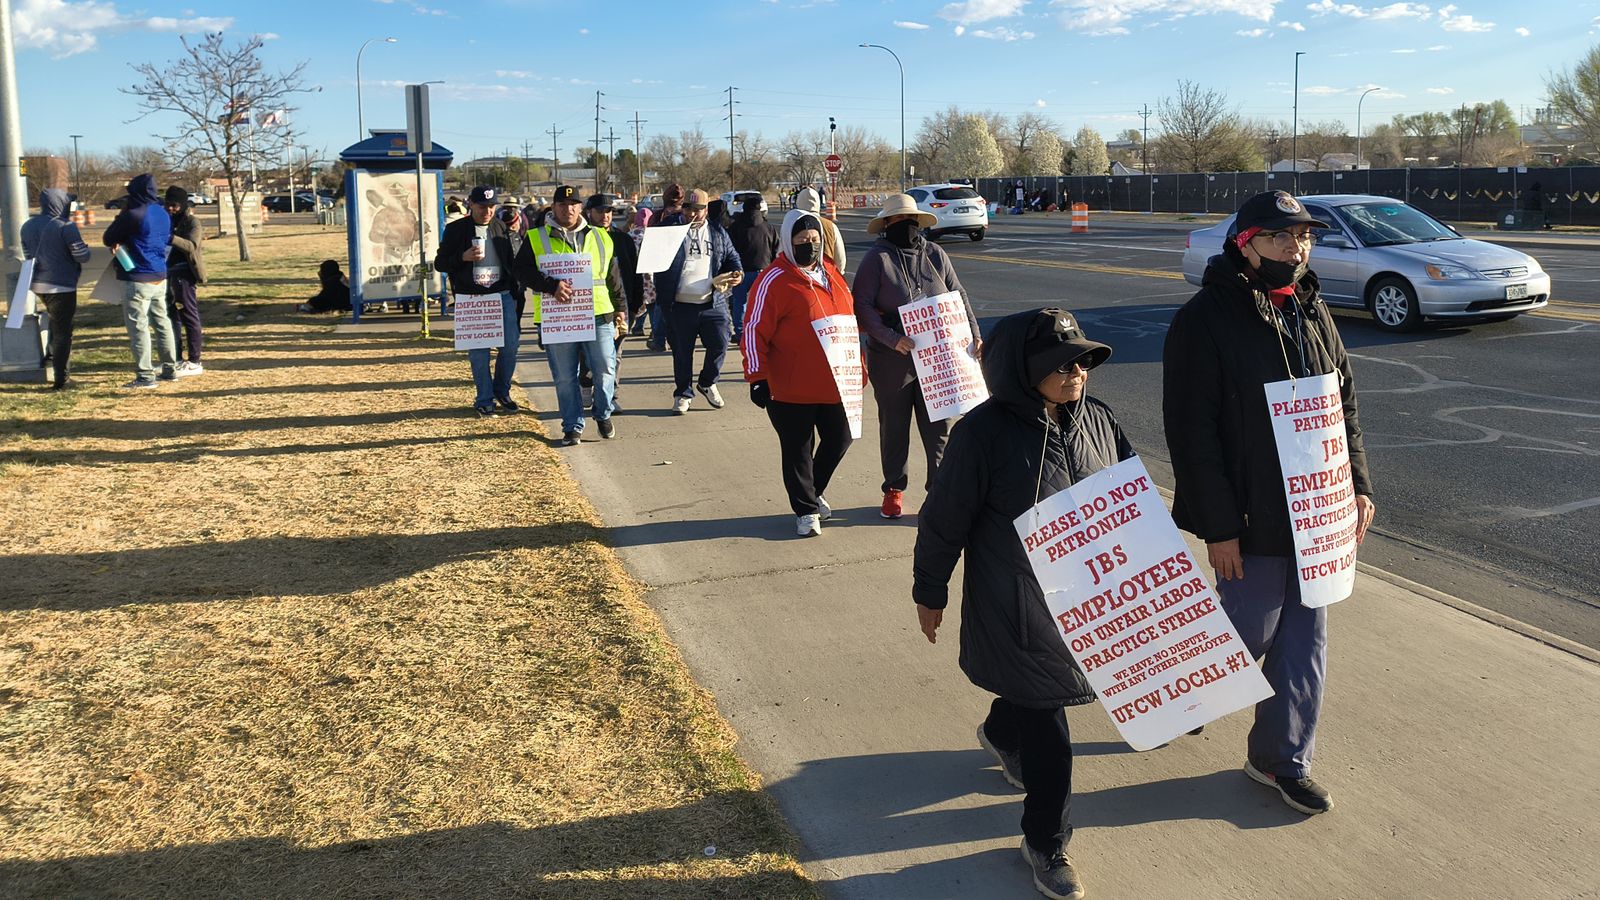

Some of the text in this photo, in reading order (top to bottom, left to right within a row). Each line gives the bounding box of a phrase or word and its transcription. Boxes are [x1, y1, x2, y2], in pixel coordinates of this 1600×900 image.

[825, 160, 841, 168] STOP
[566, 187, 573, 197] P
[368, 264, 402, 277] ONLY
[547, 267, 584, 276] PATRONIZE
[456, 300, 502, 310] EMPLOYEES
[902, 305, 936, 324] FAVOR
[937, 301, 950, 314] DE
[933, 328, 952, 342] JBS
[922, 356, 932, 367] EN
[920, 369, 957, 386] LABORALES
[924, 386, 932, 394] NO
[933, 378, 960, 391] TENEMOS
[924, 392, 938, 402] CON
[939, 388, 958, 398] OTRAS
[932, 398, 956, 410] UFCW
[1272, 396, 1328, 416] PLEASE
[1322, 435, 1344, 462] JBS
[1292, 498, 1310, 512] ON
[1312, 488, 1346, 508] UNFAIR
[1024, 476, 1149, 552] PLEASE DO NOT
[1294, 507, 1346, 532] PRACTICE
[1046, 502, 1142, 563] PATRONIZE
[1312, 536, 1324, 545] WE
[1325, 531, 1340, 543] HAVE
[1300, 546, 1320, 557] WITH
[1322, 542, 1335, 552] ANY
[1084, 544, 1128, 586] JBS
[1300, 559, 1338, 580] UFCW
[1057, 551, 1193, 635] EMPLOYEES
[1070, 577, 1207, 653] ON UNFAIR LABOR
[1081, 597, 1218, 673] PRACTICE STRIKE
[1102, 632, 1233, 698] WITH ANY OTHER EMPLOYER
[1113, 630, 1210, 682] WE HAVE NO DISPUTE
[1111, 650, 1250, 724] UFCW LOCAL #7
